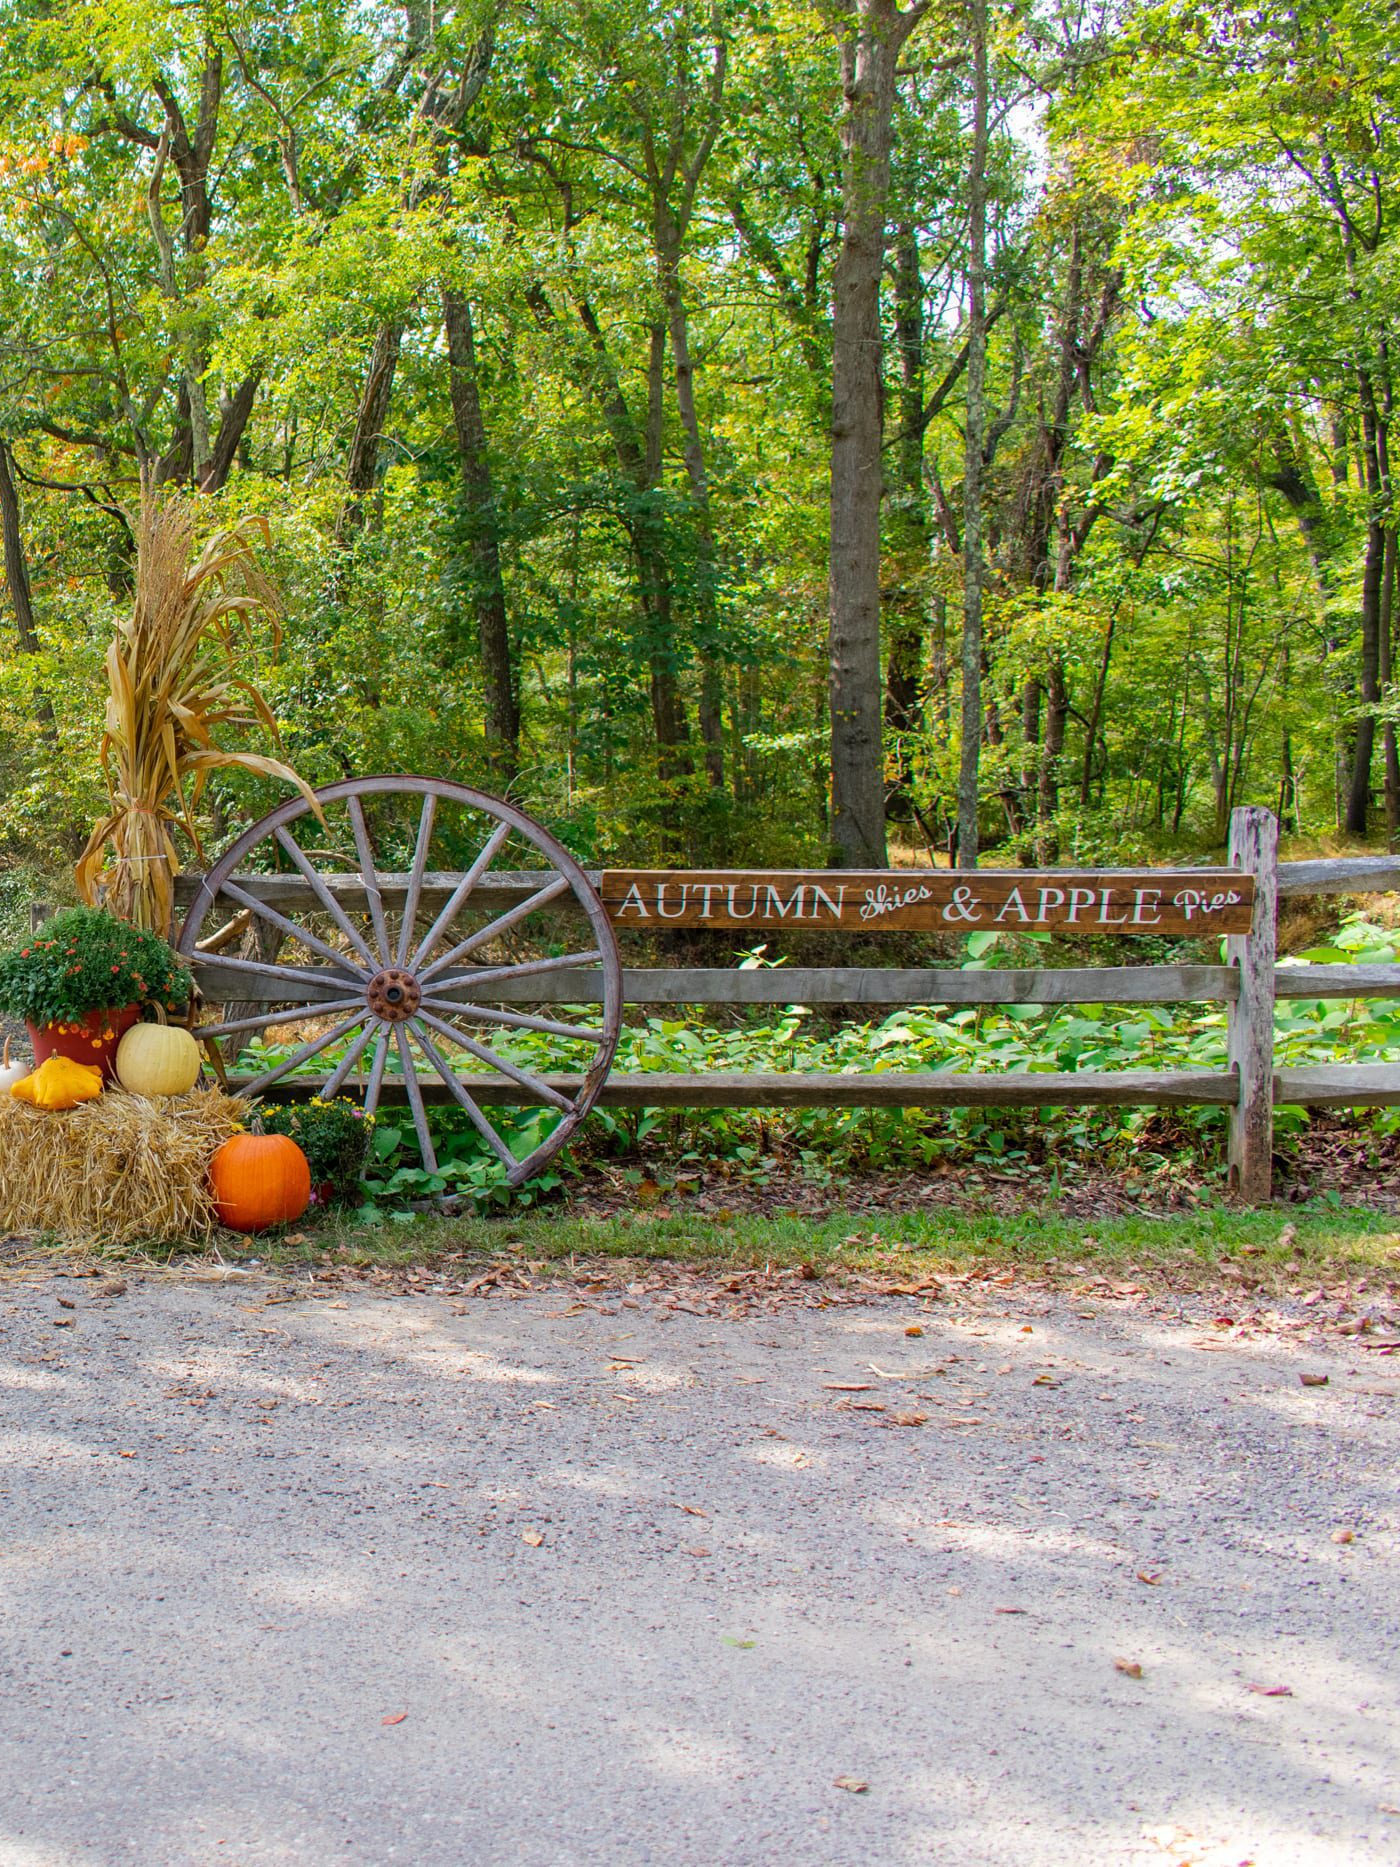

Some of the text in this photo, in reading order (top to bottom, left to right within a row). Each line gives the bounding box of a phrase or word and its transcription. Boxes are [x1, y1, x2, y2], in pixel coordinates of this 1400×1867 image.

[616, 883, 1241, 924] AUTUMN Skies & APPLE Pies
